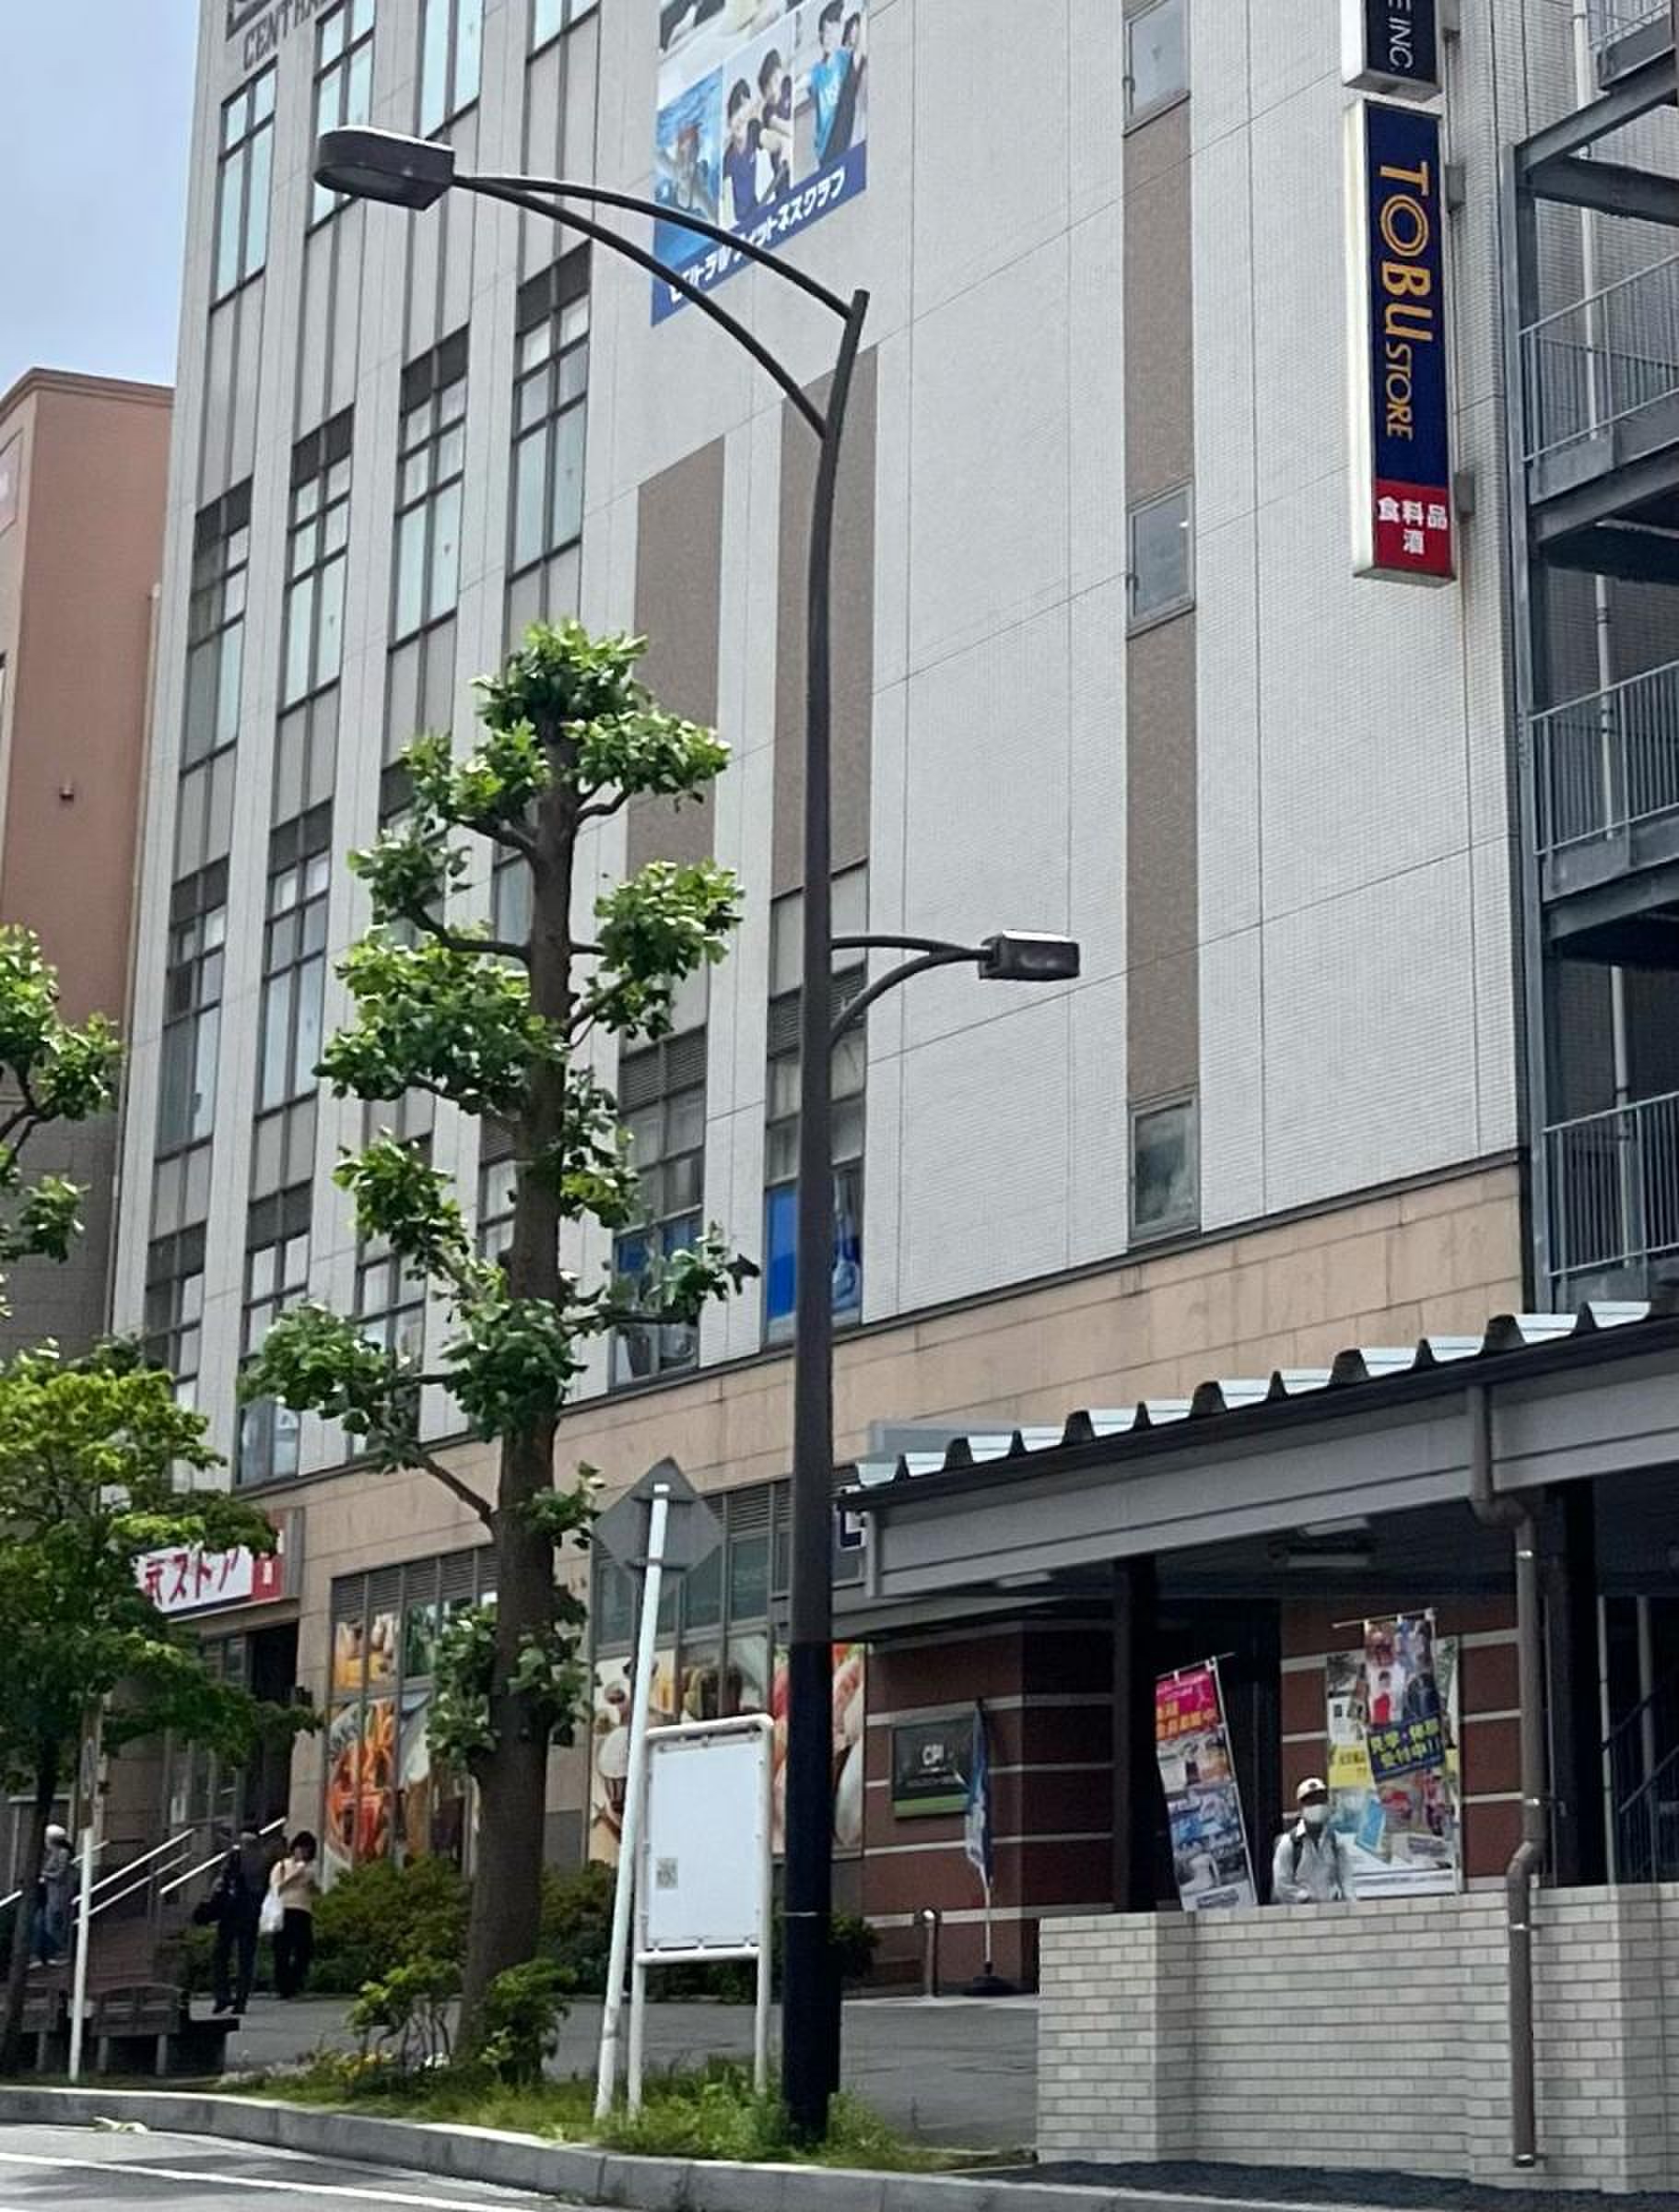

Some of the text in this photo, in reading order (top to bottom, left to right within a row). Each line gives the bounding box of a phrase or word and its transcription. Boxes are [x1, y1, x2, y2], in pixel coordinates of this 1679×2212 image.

[243, 0, 324, 71] CENTR
[1380, 161, 1432, 441] TOBU STORE
